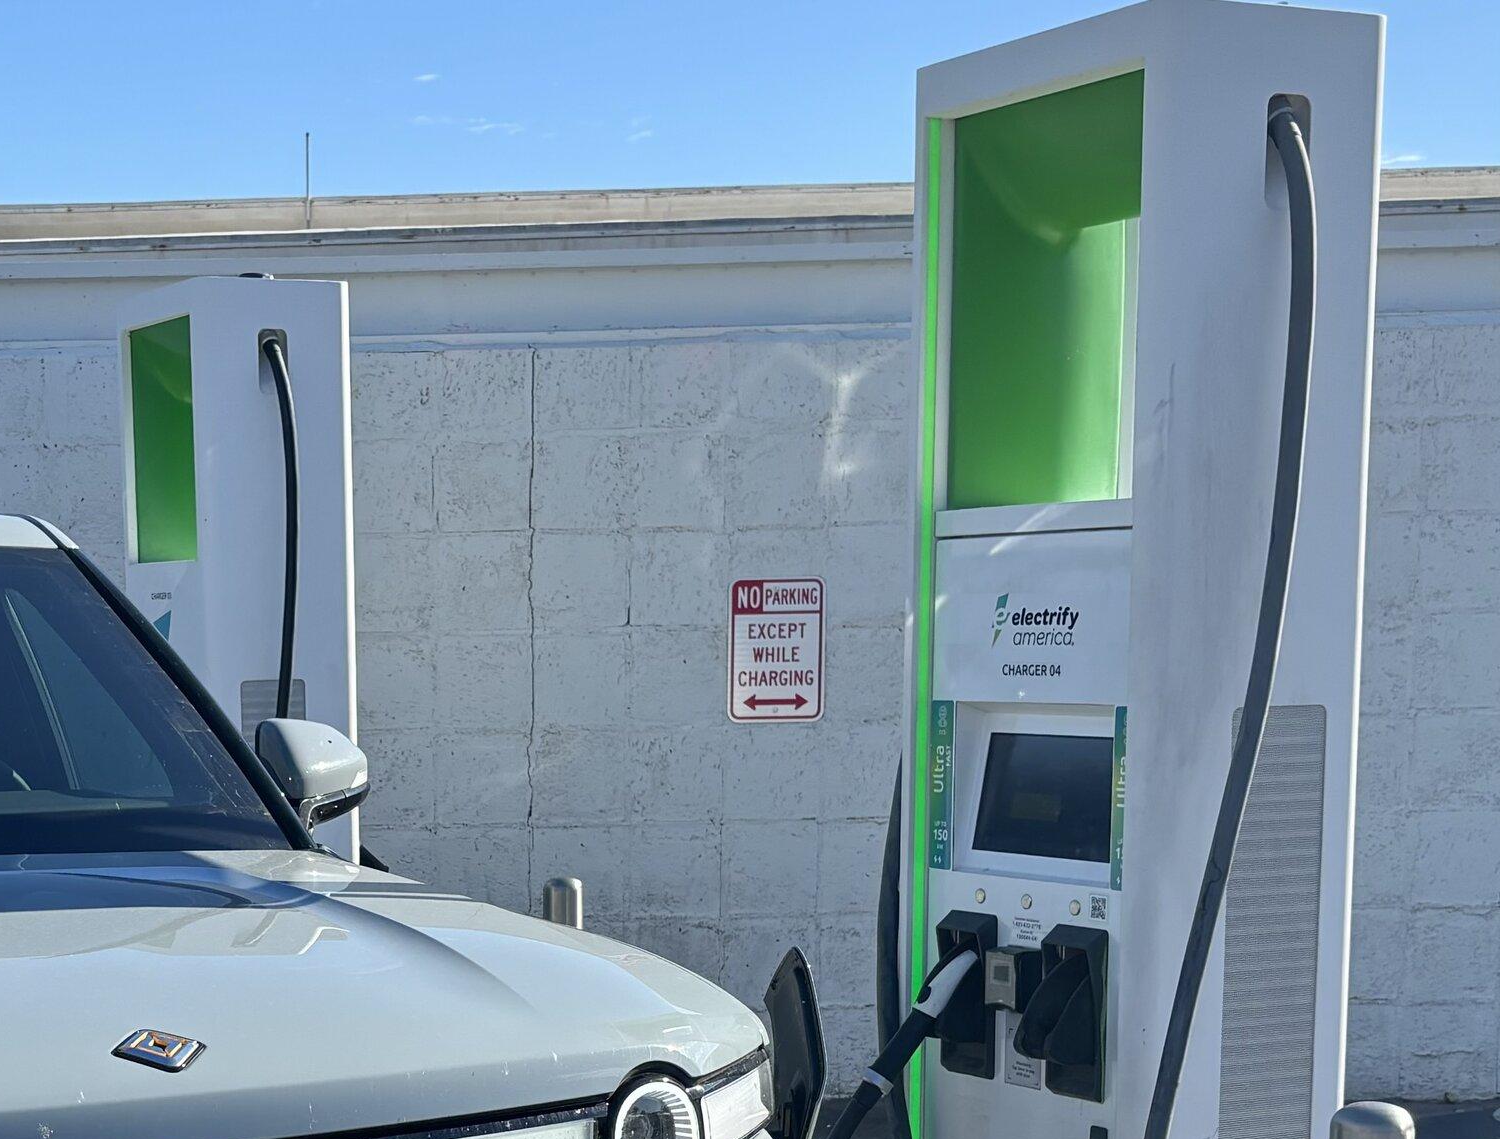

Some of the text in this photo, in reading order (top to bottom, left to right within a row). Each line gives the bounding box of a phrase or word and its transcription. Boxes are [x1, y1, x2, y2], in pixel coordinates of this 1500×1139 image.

[737, 586, 818, 609] NO PARKING
[1011, 606, 1079, 630] electrify
[748, 622, 807, 639] EXCEPT
[753, 647, 800, 663] WHILE
[738, 670, 814, 687] CHARGING
[1002, 664, 1061, 677] CHARGER 04
[933, 745, 944, 793] Ultra
[933, 829, 948, 841] 150
